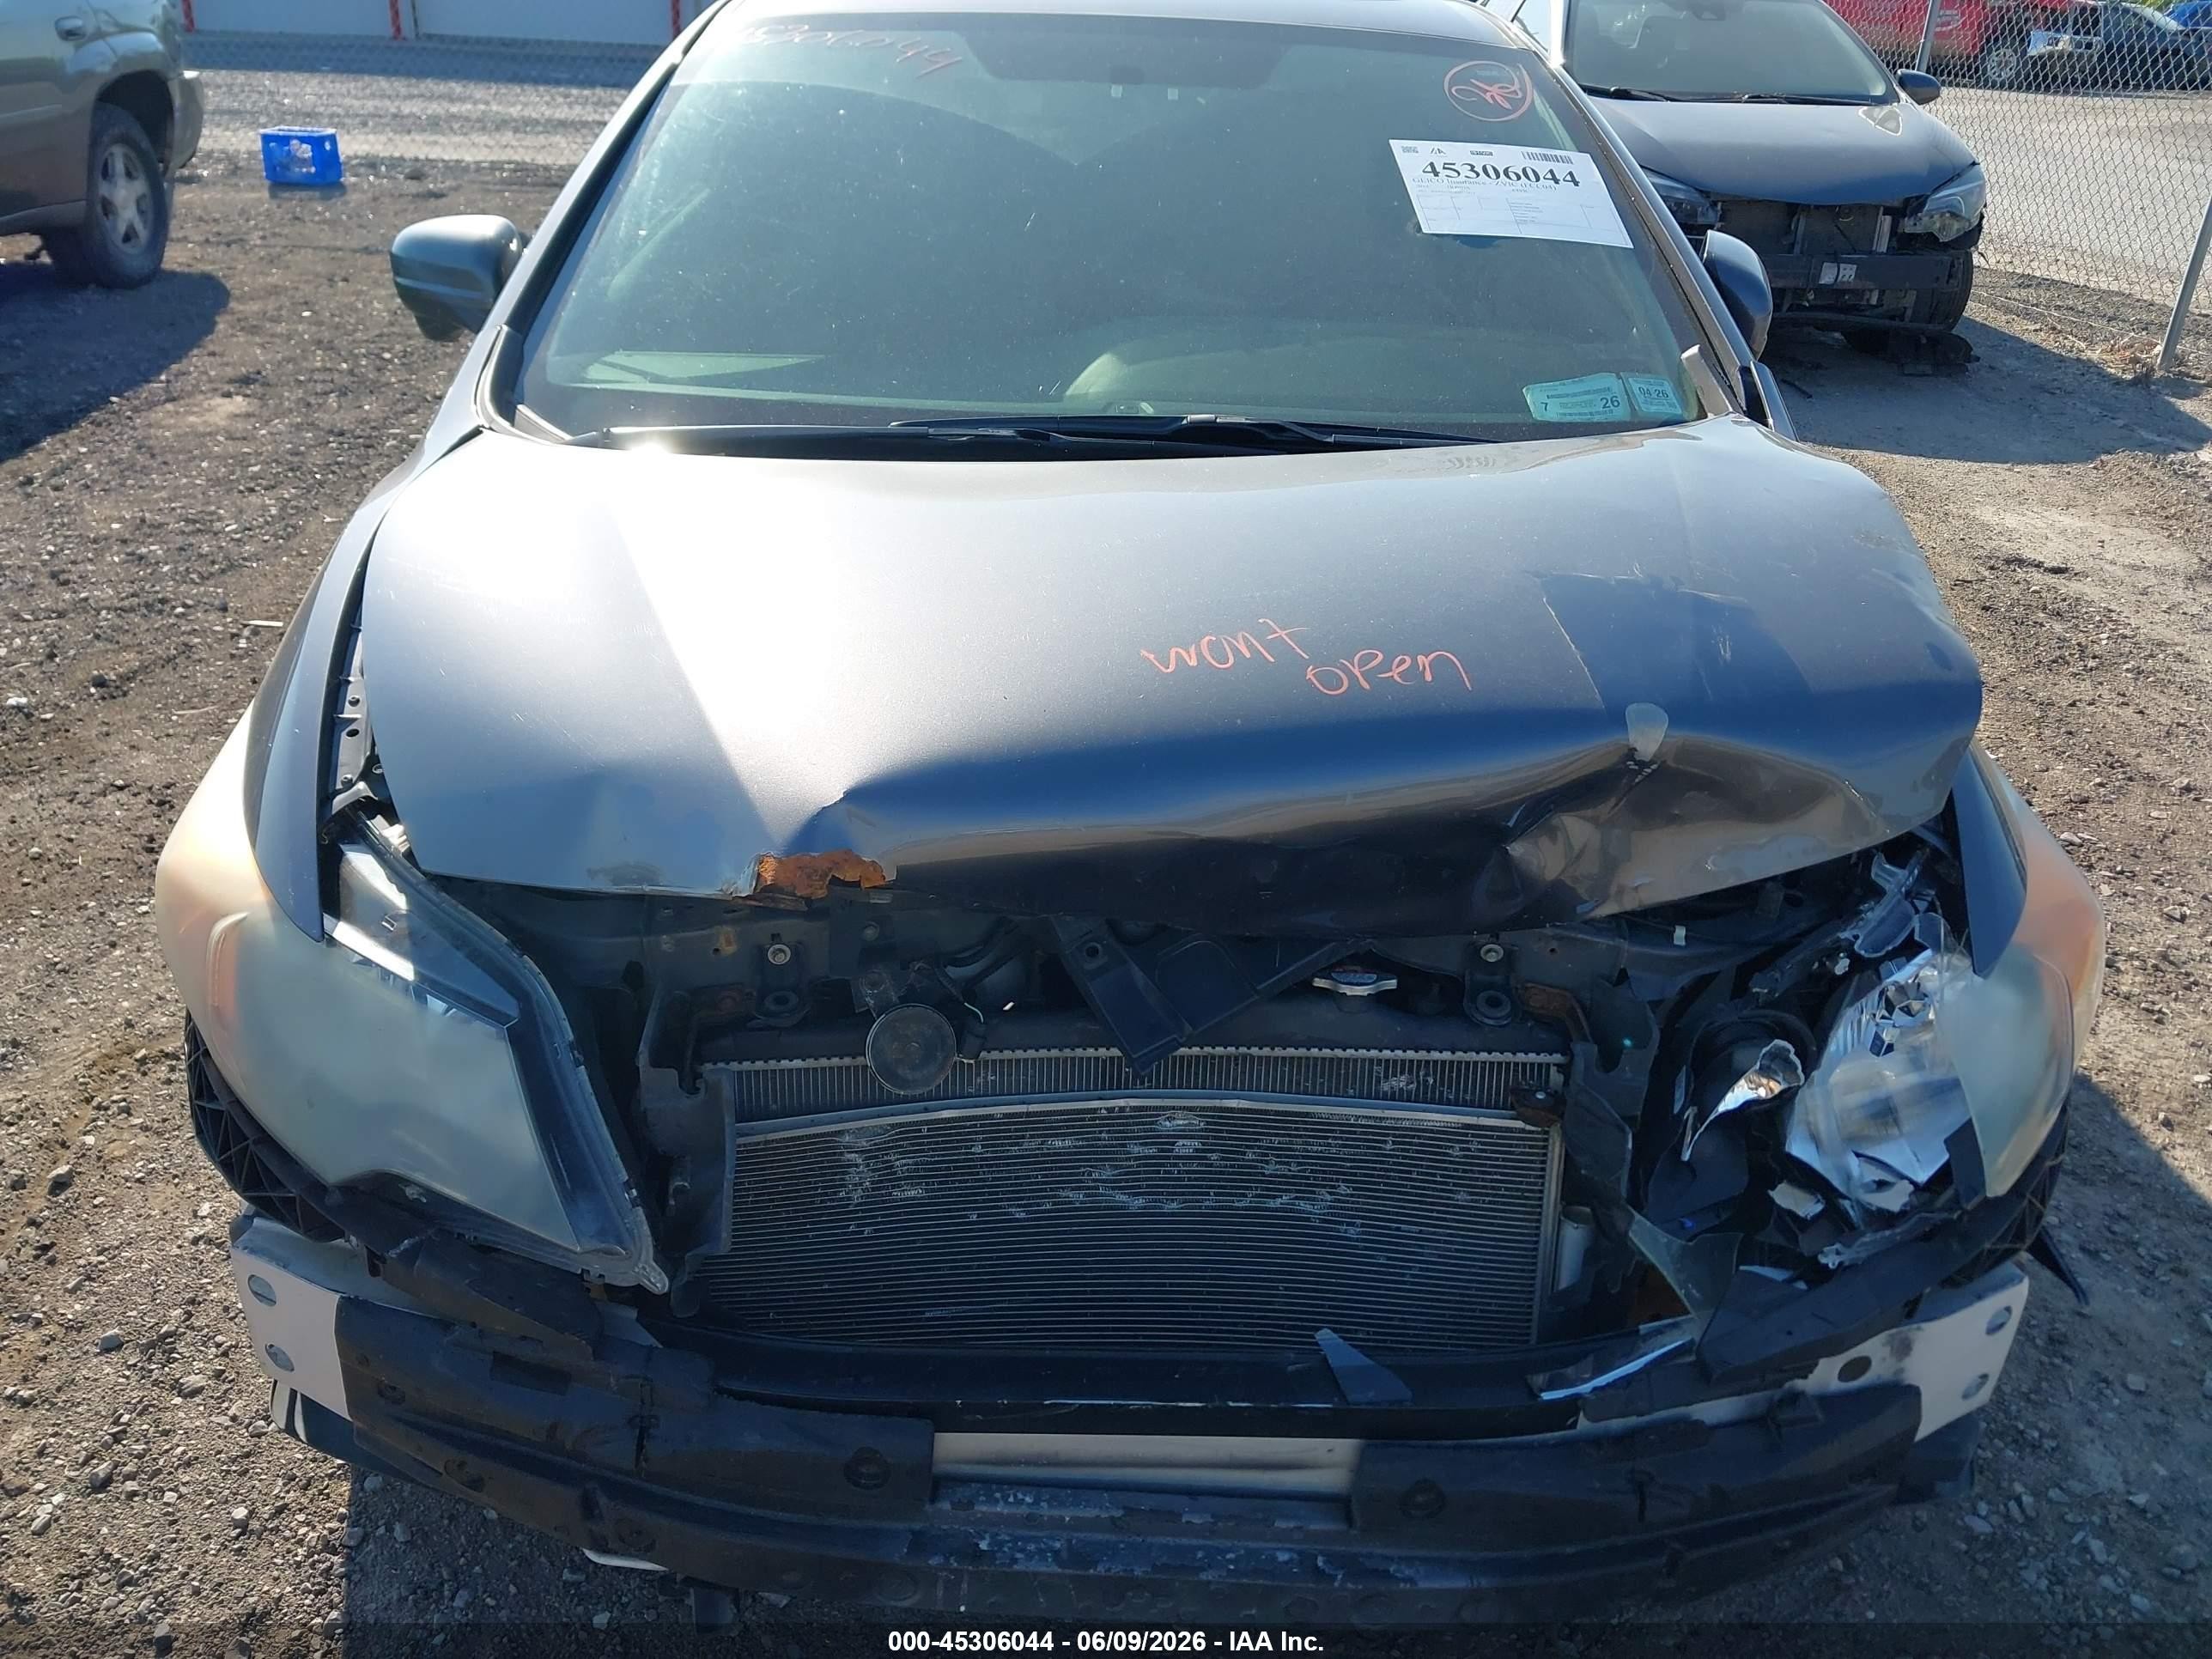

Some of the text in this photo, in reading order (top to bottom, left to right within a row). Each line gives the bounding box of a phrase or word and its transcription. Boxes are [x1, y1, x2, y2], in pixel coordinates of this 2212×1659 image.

[1422, 161, 1581, 187] 45306044
[1540, 401, 1549, 412] 7
[1600, 395, 1620, 410] 26
[1139, 617, 1311, 674] wont
